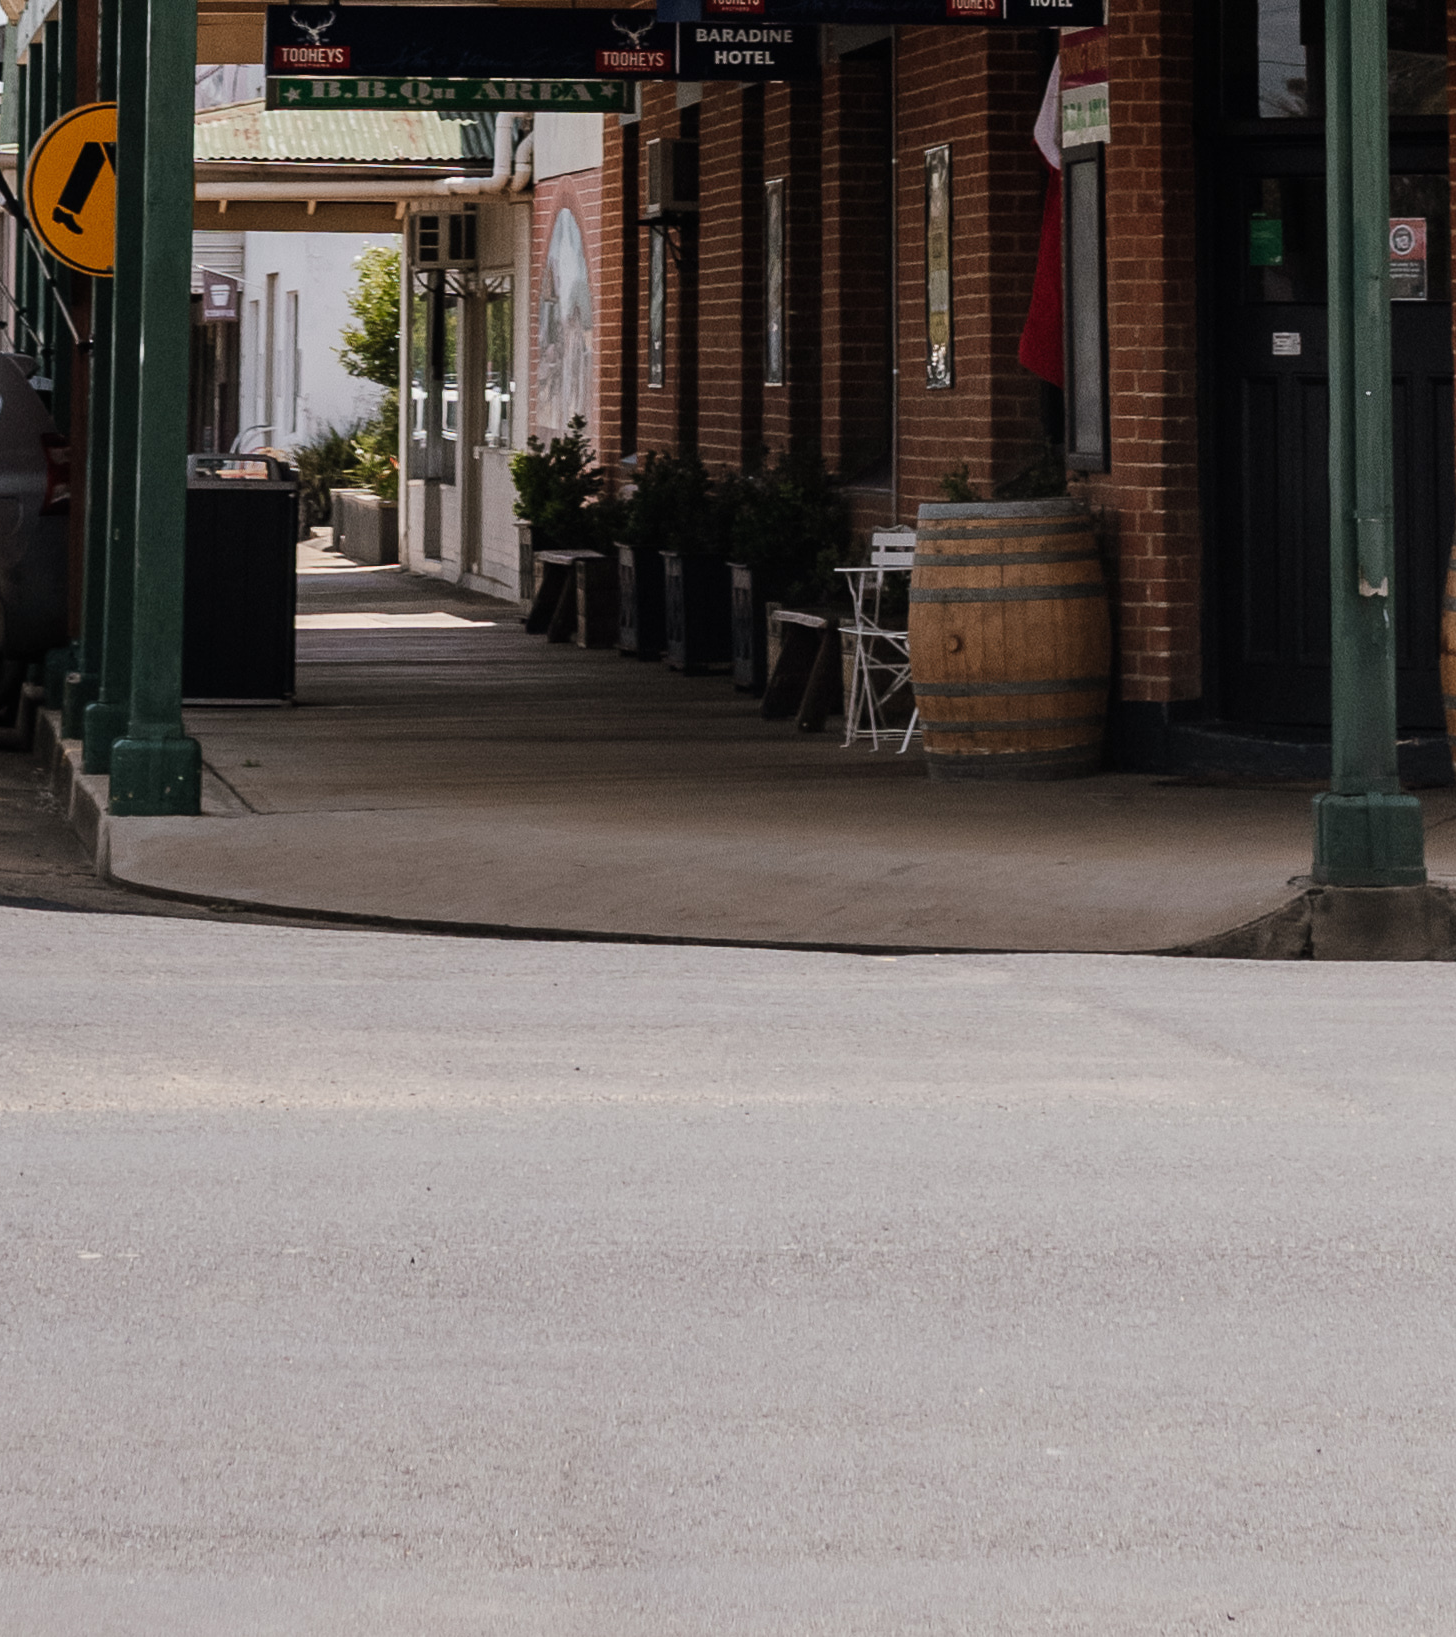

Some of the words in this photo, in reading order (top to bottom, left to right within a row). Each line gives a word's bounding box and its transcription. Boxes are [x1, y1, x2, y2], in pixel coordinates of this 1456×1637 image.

[695, 28, 793, 43] BARADINE
[281, 48, 344, 63] TOOHEYS
[602, 51, 664, 67] TOOHEYS
[714, 50, 775, 65] HOTEL
[471, 81, 594, 102] AREA
